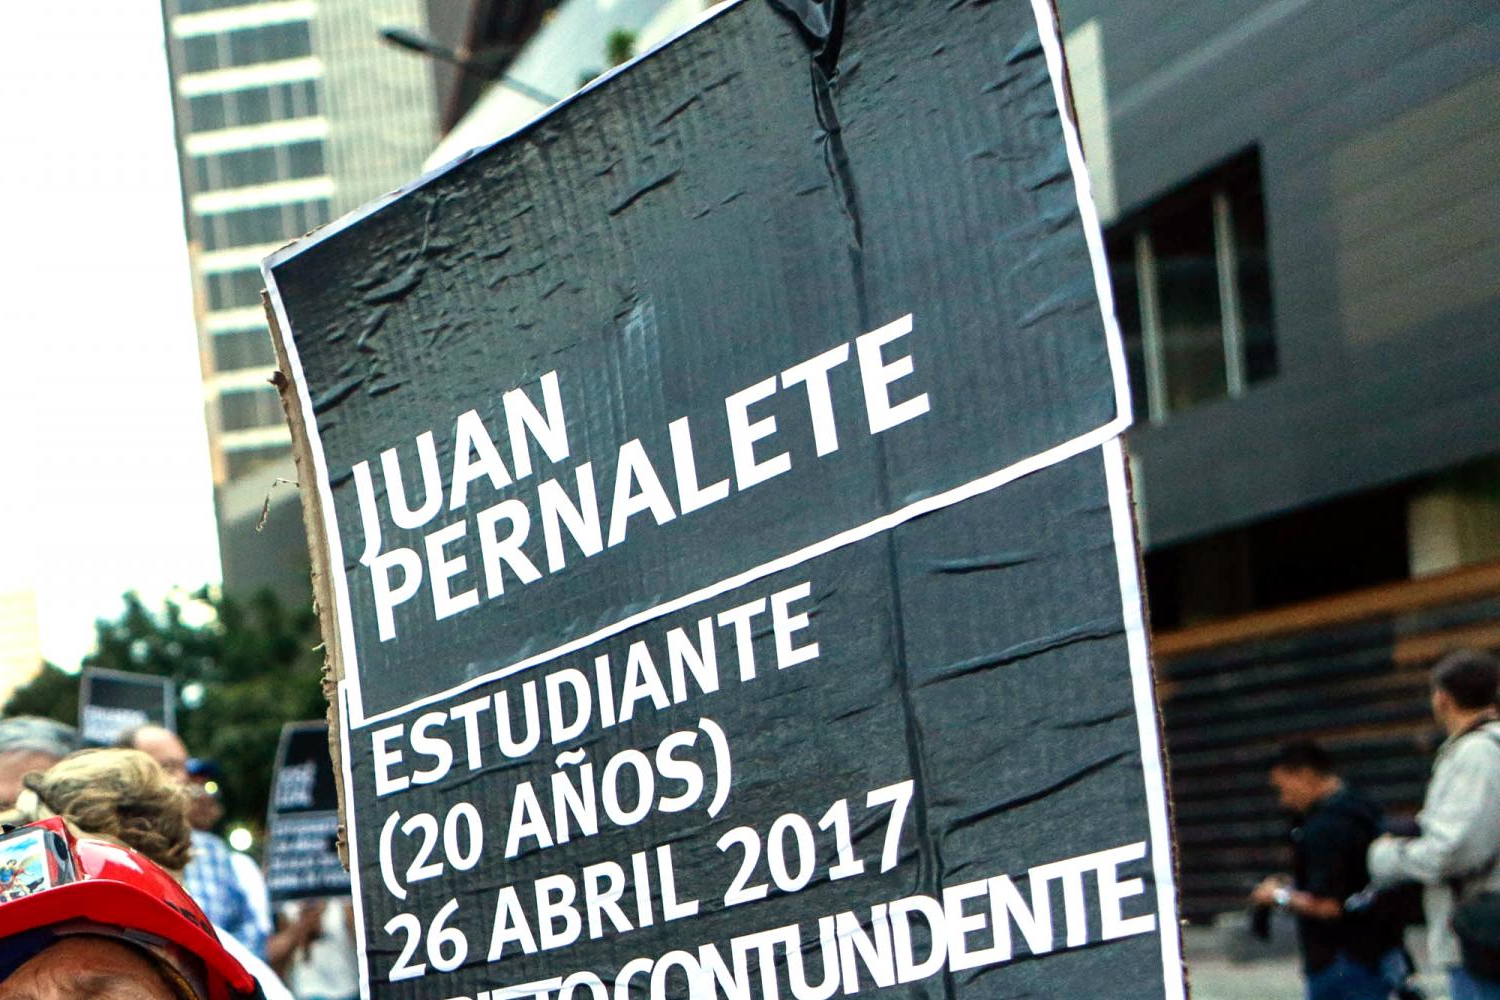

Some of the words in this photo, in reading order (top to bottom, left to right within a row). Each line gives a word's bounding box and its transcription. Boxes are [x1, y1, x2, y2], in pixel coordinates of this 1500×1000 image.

[352, 371, 570, 566] JUAN
[366, 314, 931, 643] PERNALETE
[372, 582, 820, 797] ESTUDIANTE
[380, 803, 483, 900] (20
[505, 718, 732, 859] AÑOS)
[384, 899, 468, 982] 26
[488, 845, 699, 962] ABRIL
[717, 780, 914, 907] 2017
